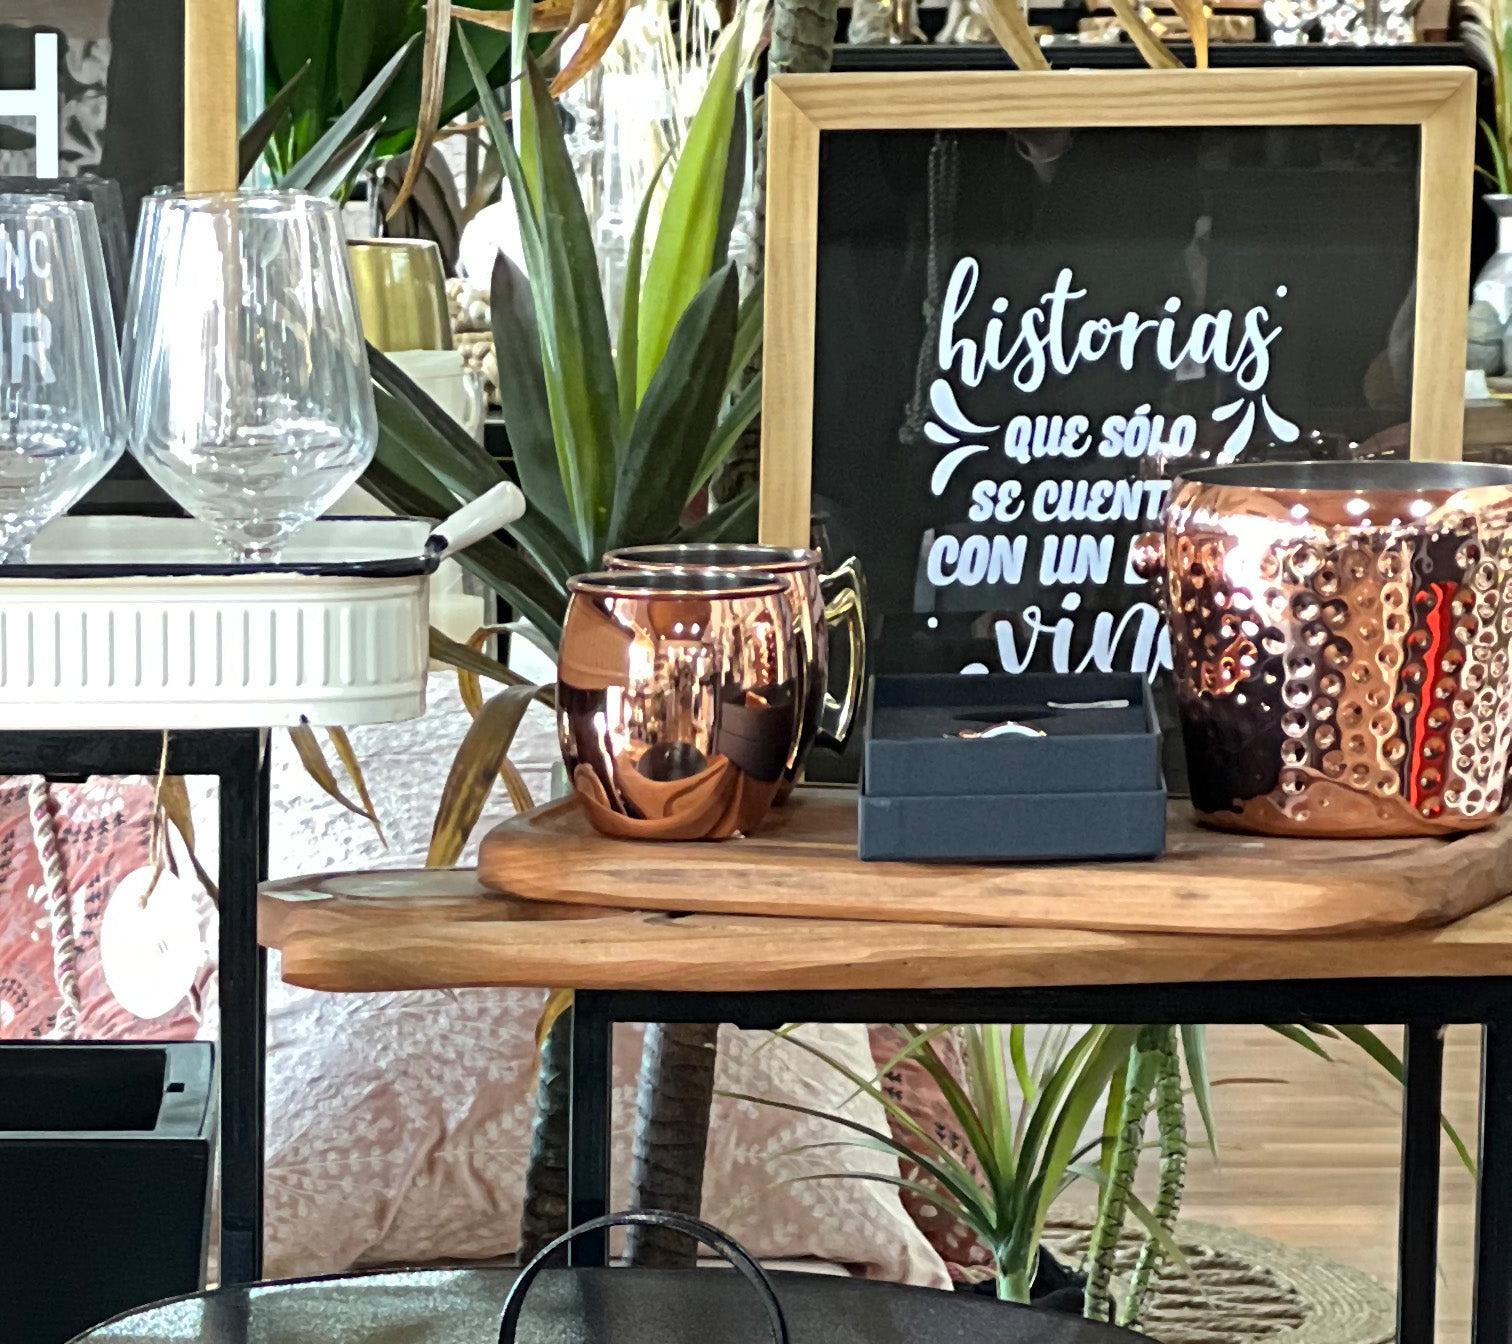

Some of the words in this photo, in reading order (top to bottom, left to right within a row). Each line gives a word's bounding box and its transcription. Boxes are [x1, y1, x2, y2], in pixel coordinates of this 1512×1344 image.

[938, 256, 1283, 392] historias
[1004, 415, 1092, 464] QUE
[1098, 403, 1197, 457] SÓLO
[968, 479, 1025, 522] SE
[1032, 479, 1172, 522] CUENT
[926, 534, 1028, 586] CON
[1039, 534, 1114, 586] UN
[994, 592, 1175, 684] vin
